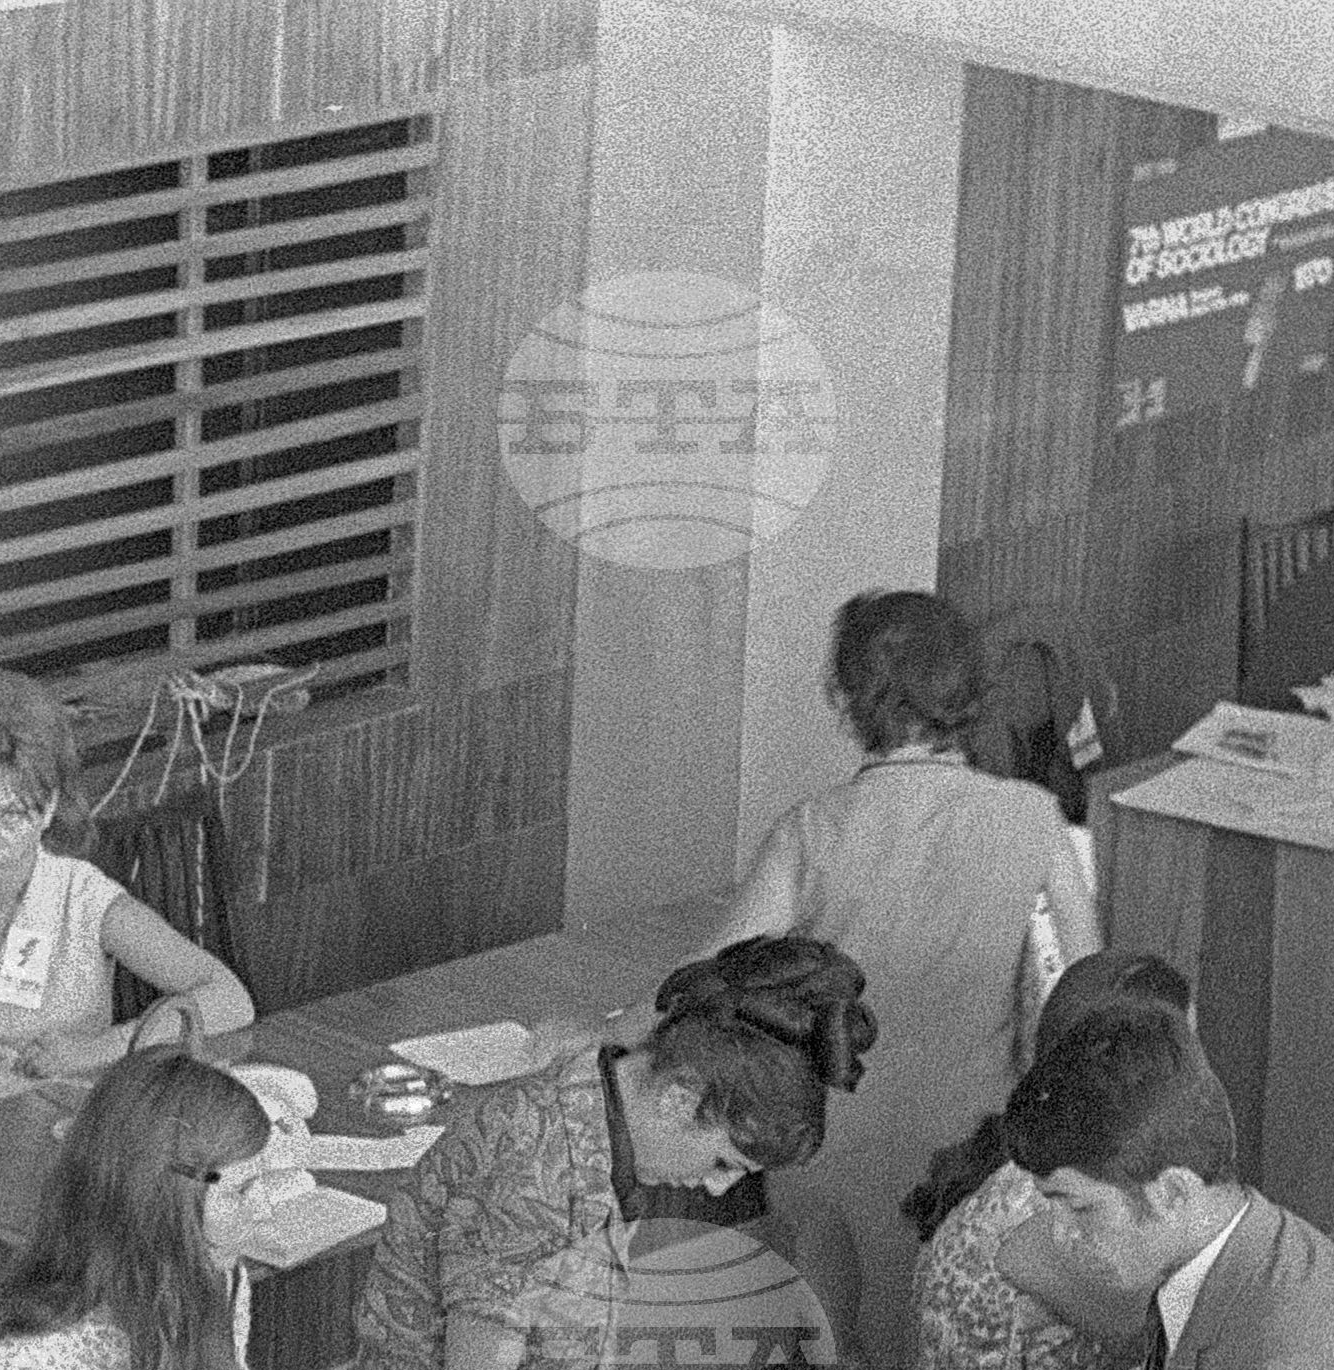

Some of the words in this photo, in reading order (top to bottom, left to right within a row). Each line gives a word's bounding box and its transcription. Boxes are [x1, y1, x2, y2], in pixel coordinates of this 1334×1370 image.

[1162, 205, 1234, 244] WORLD
[1125, 253, 1155, 285] OF
[1156, 227, 1270, 279] SOCIOLOGY
